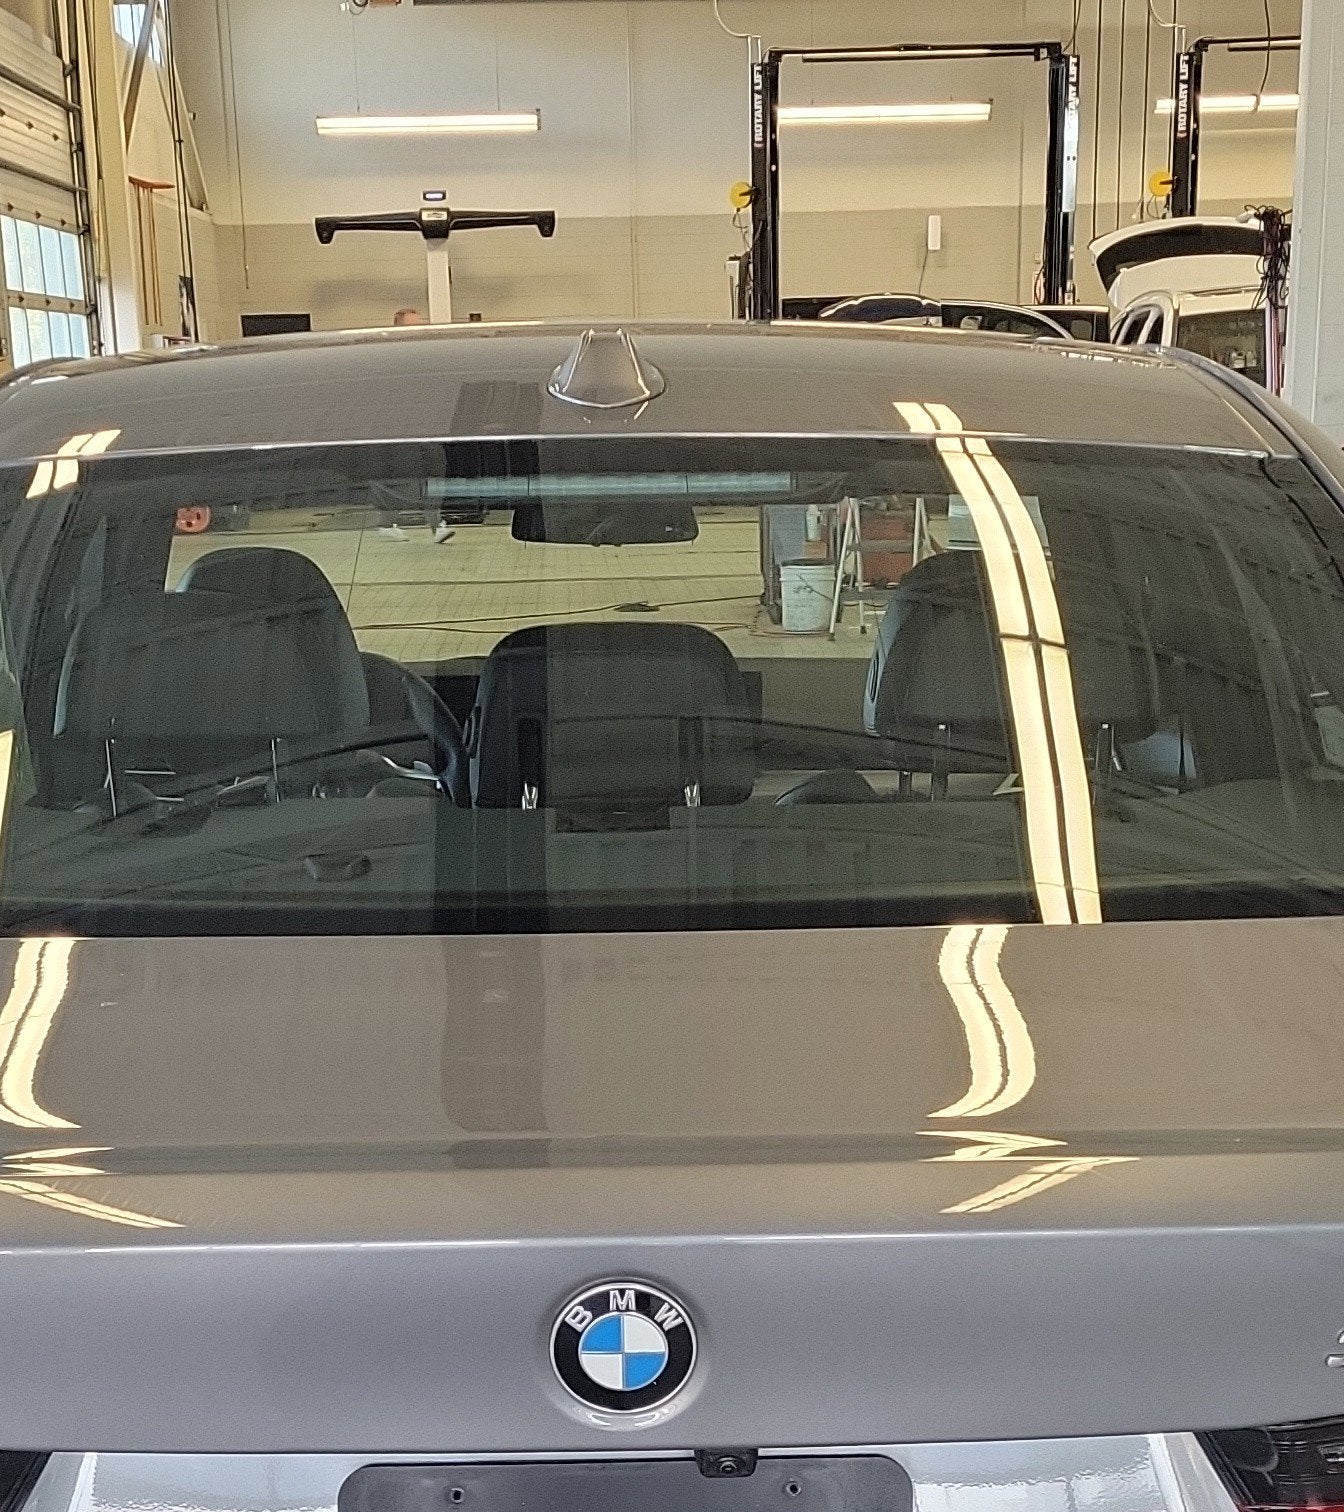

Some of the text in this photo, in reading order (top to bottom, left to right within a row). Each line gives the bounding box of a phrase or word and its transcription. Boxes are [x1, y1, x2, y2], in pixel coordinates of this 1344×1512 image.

[1068, 55, 1078, 82] LIFT
[1177, 53, 1190, 131] ROTARY LIFT
[753, 64, 763, 142] ROTARY LIFT
[563, 1288, 685, 1334] BMW
